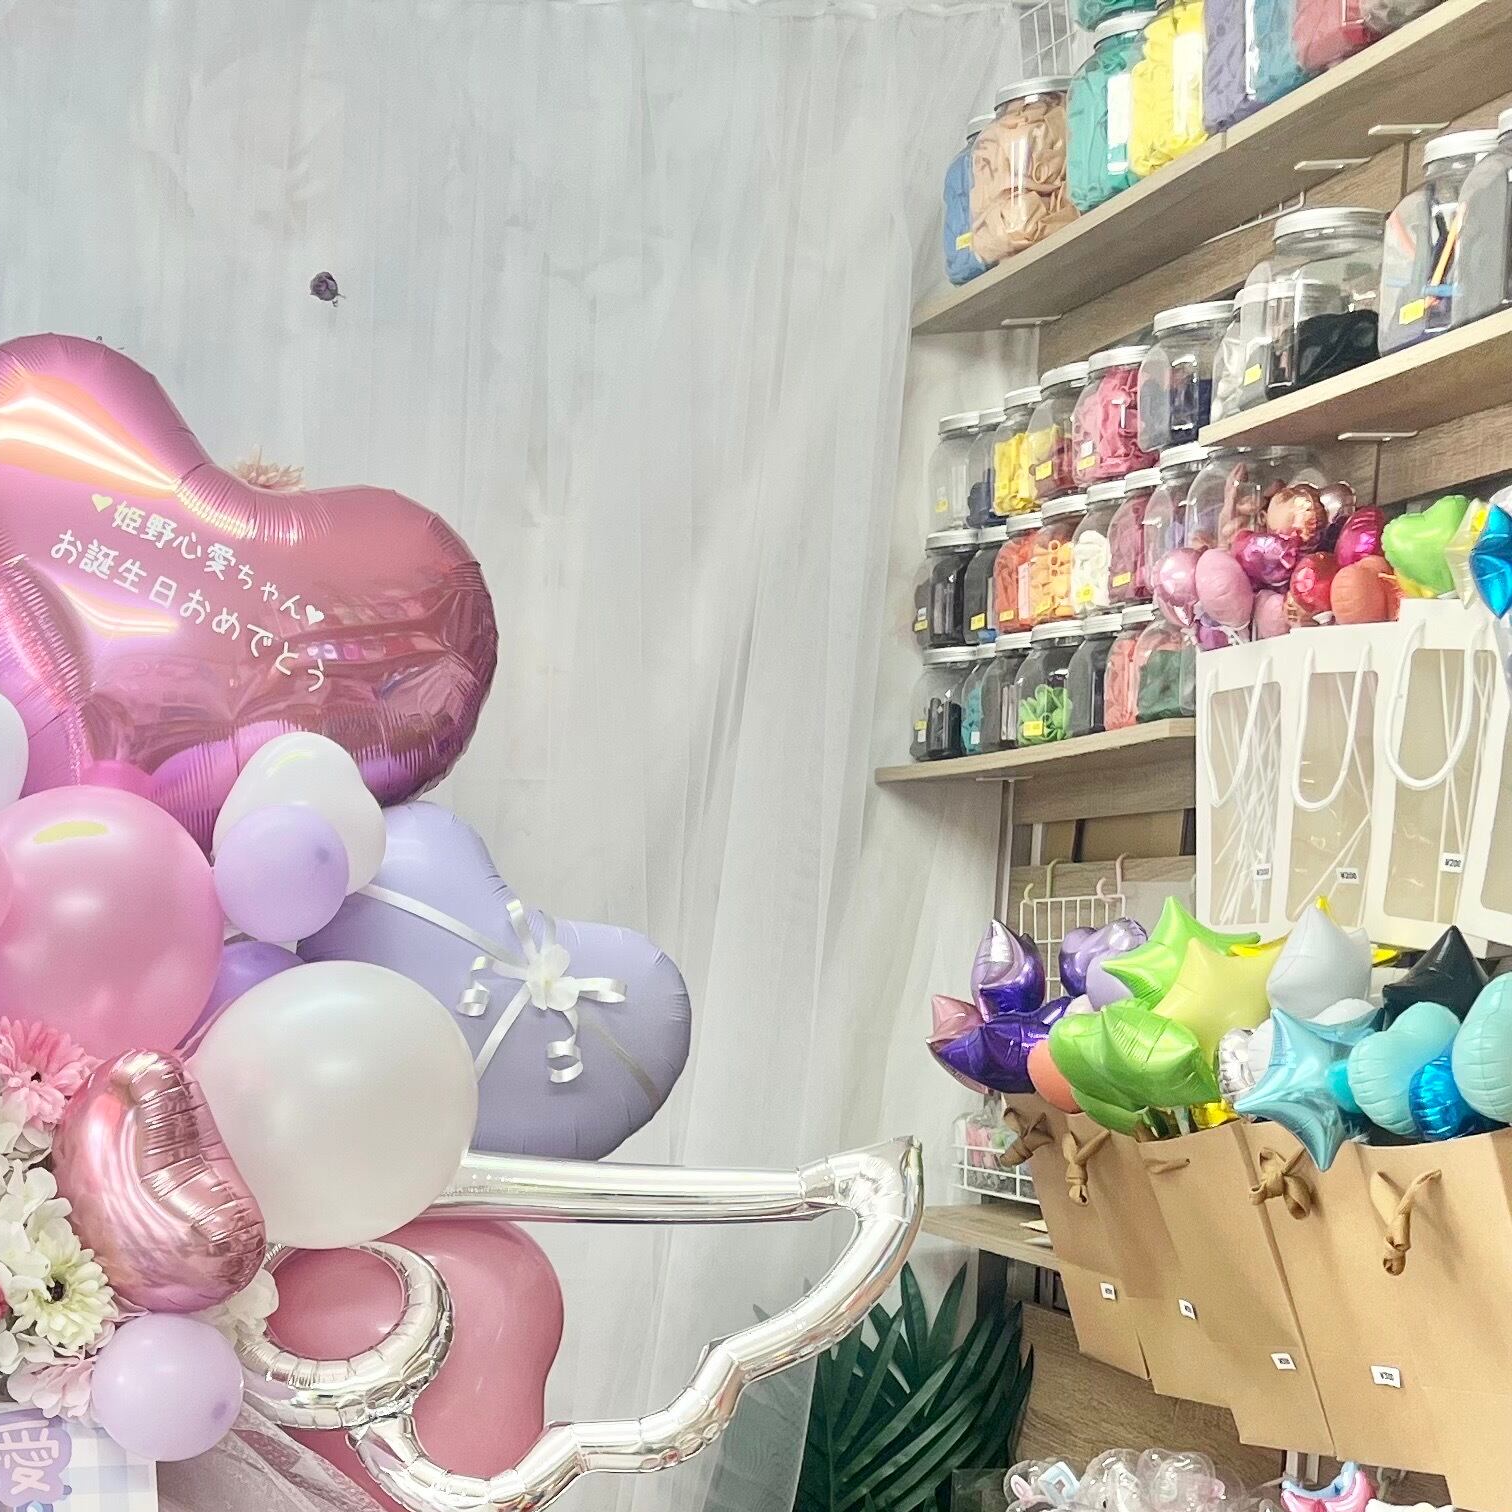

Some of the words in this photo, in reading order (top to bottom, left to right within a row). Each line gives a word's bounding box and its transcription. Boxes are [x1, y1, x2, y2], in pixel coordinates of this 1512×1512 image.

[50, 529, 325, 692] お誕生日おめでとう
